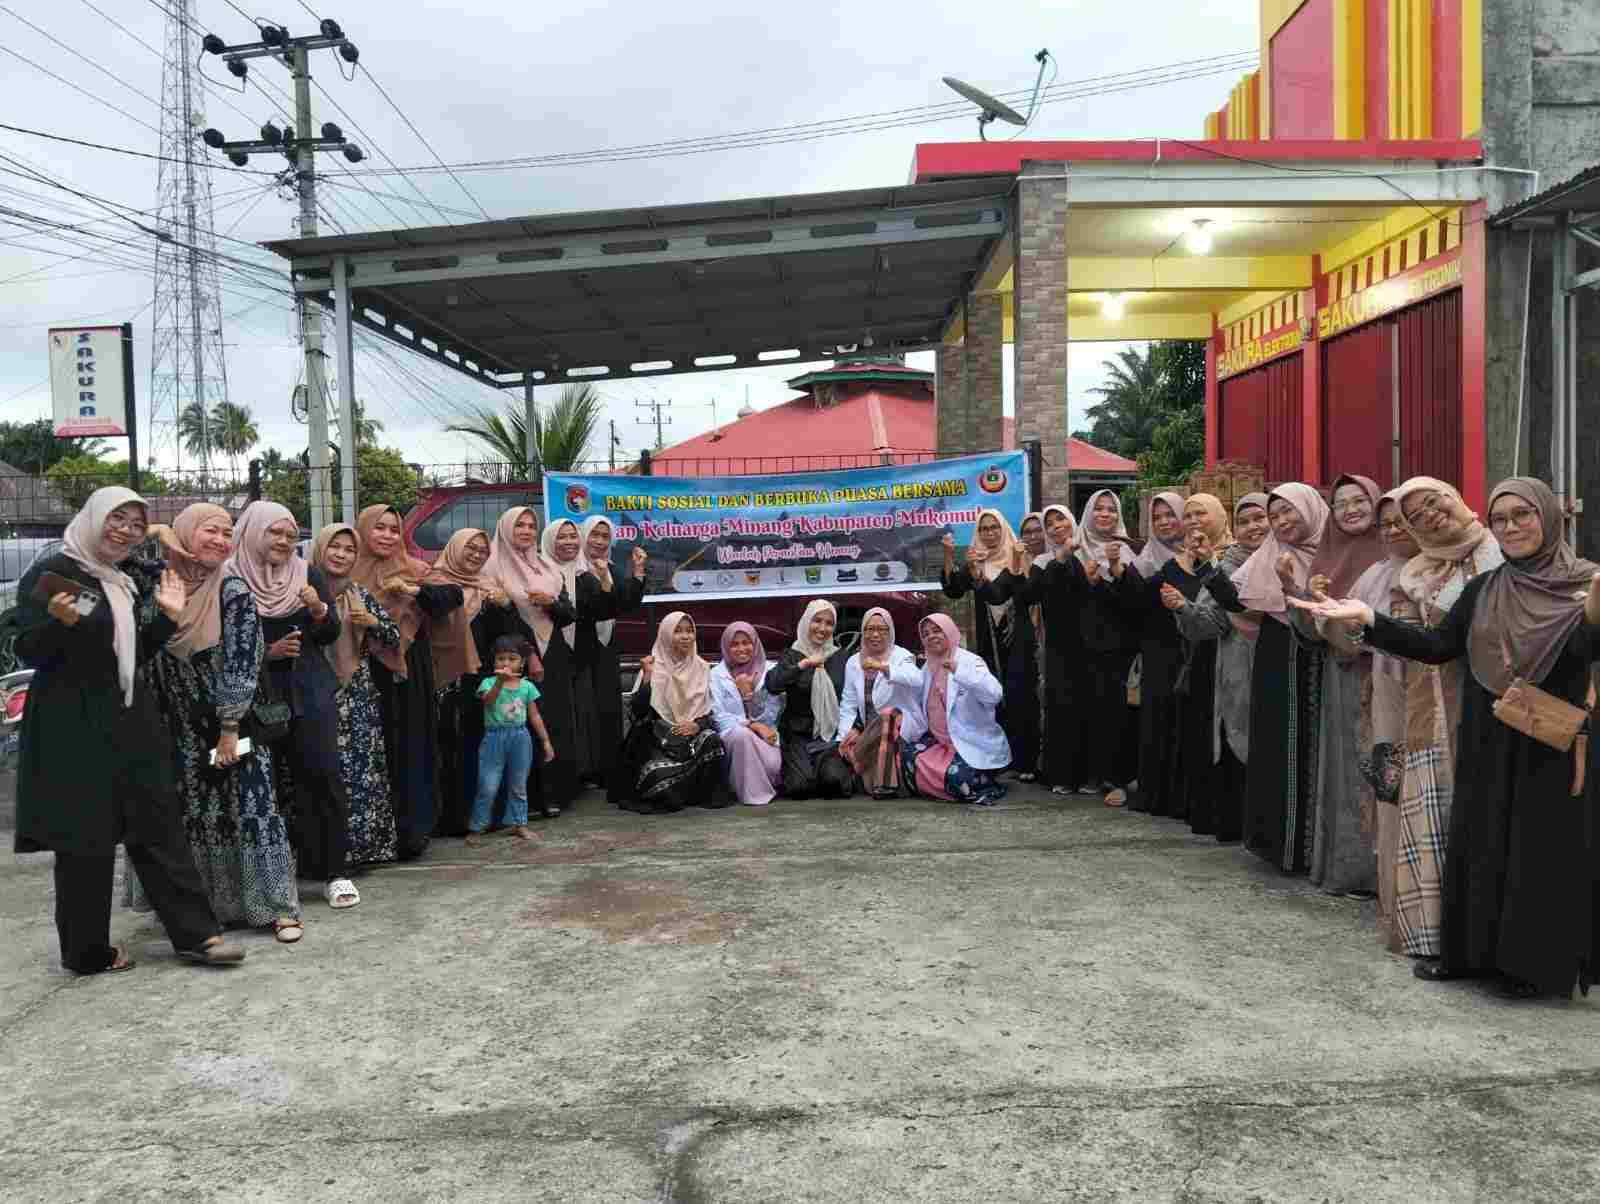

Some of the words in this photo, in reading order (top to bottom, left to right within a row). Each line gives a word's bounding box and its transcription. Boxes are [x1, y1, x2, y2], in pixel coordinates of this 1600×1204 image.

[77, 332, 97, 416] SAKURA
[606, 495, 653, 512] BAKTI
[656, 494, 713, 511] SOSIAL
[718, 495, 750, 507] DAN
[754, 489, 830, 508] BERBUKA
[832, 485, 888, 503] PUASA
[891, 480, 968, 499] BERSAMA
[640, 519, 720, 542] Keluarga
[722, 516, 794, 538] Minang
[795, 515, 895, 535] Kabupaten
